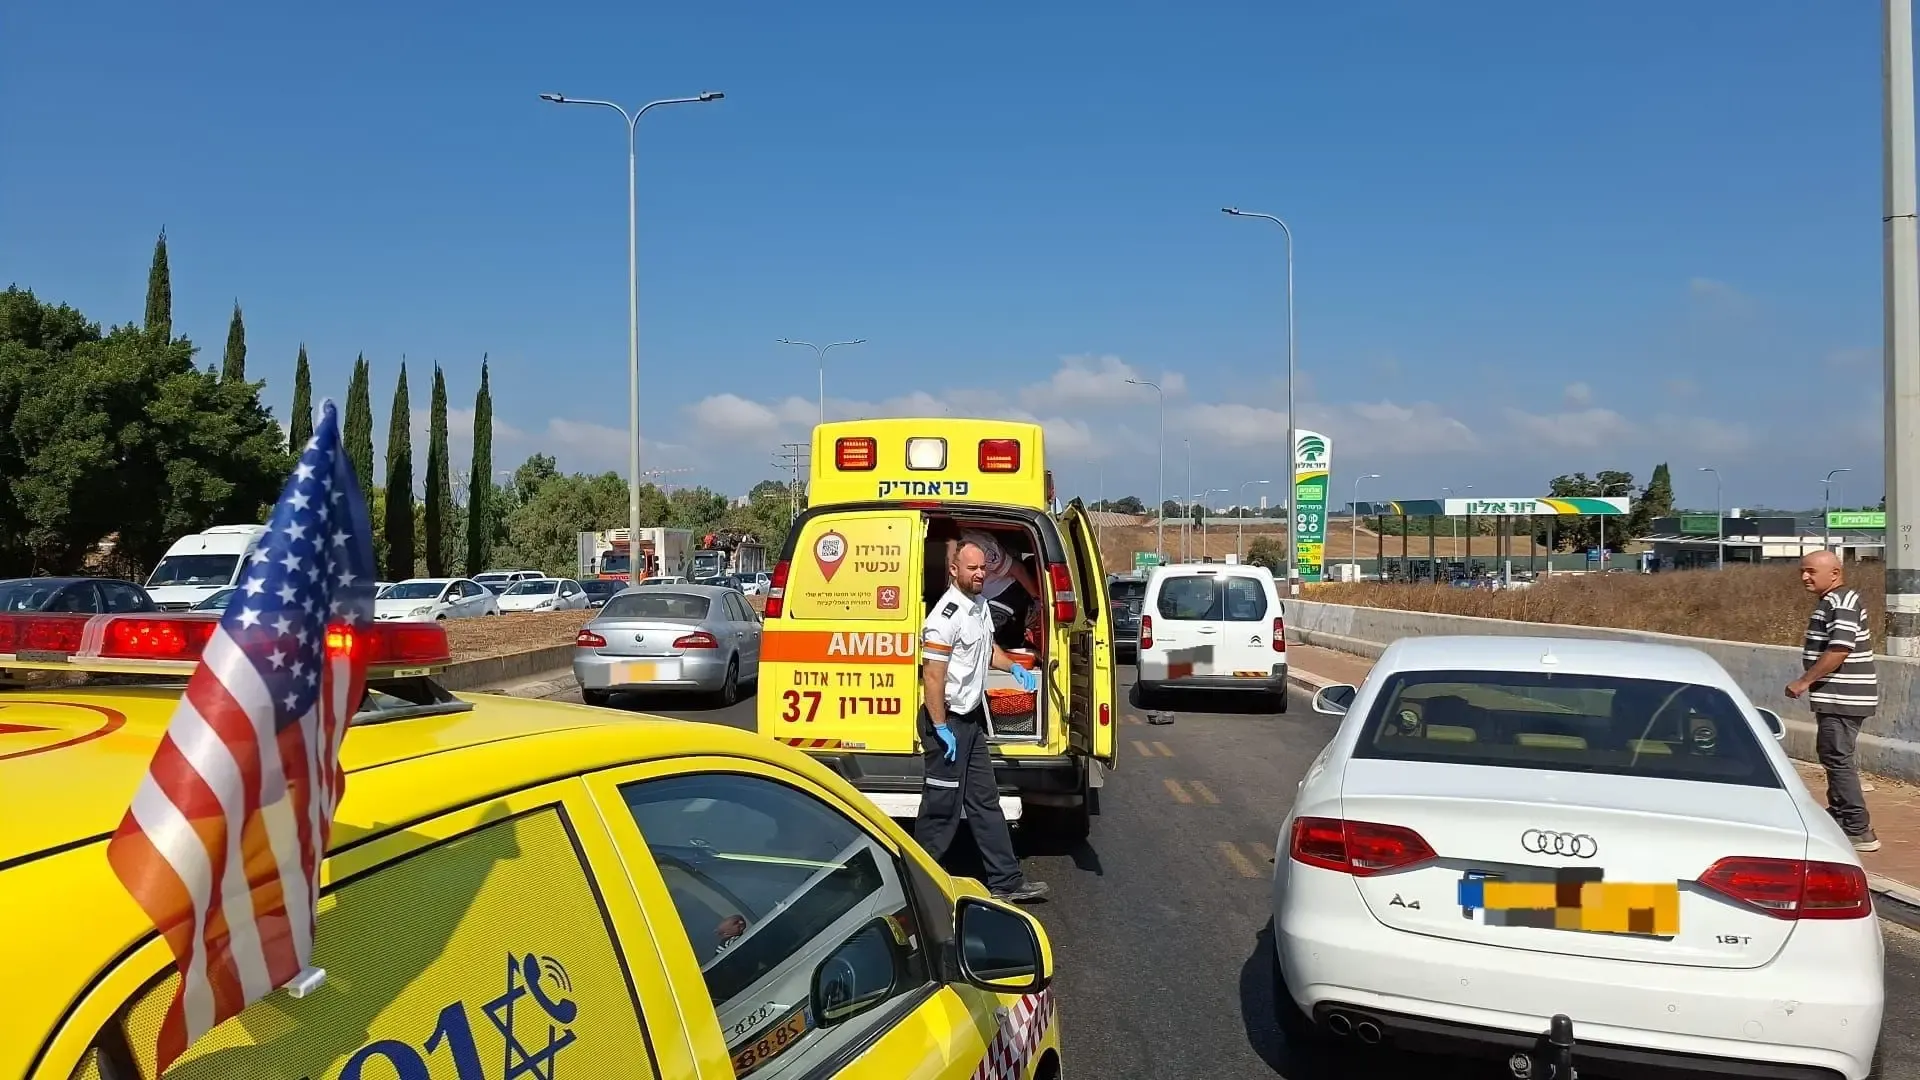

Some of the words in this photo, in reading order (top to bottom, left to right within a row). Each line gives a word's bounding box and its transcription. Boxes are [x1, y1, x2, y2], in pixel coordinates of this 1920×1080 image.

[879, 481, 968, 498] פראמדיק
[1466, 500, 1506, 514] אלון
[1509, 502, 1537, 513] דור
[856, 545, 900, 556] הורידו
[855, 561, 900, 572] עכשיו
[827, 632, 914, 656] AMBU
[794, 670, 828, 686] אדום
[836, 672, 861, 686] דוד
[870, 672, 893, 689] מגן
[782, 690, 821, 722] 37
[839, 697, 900, 719] שרון
[1389, 893, 1420, 909] A4
